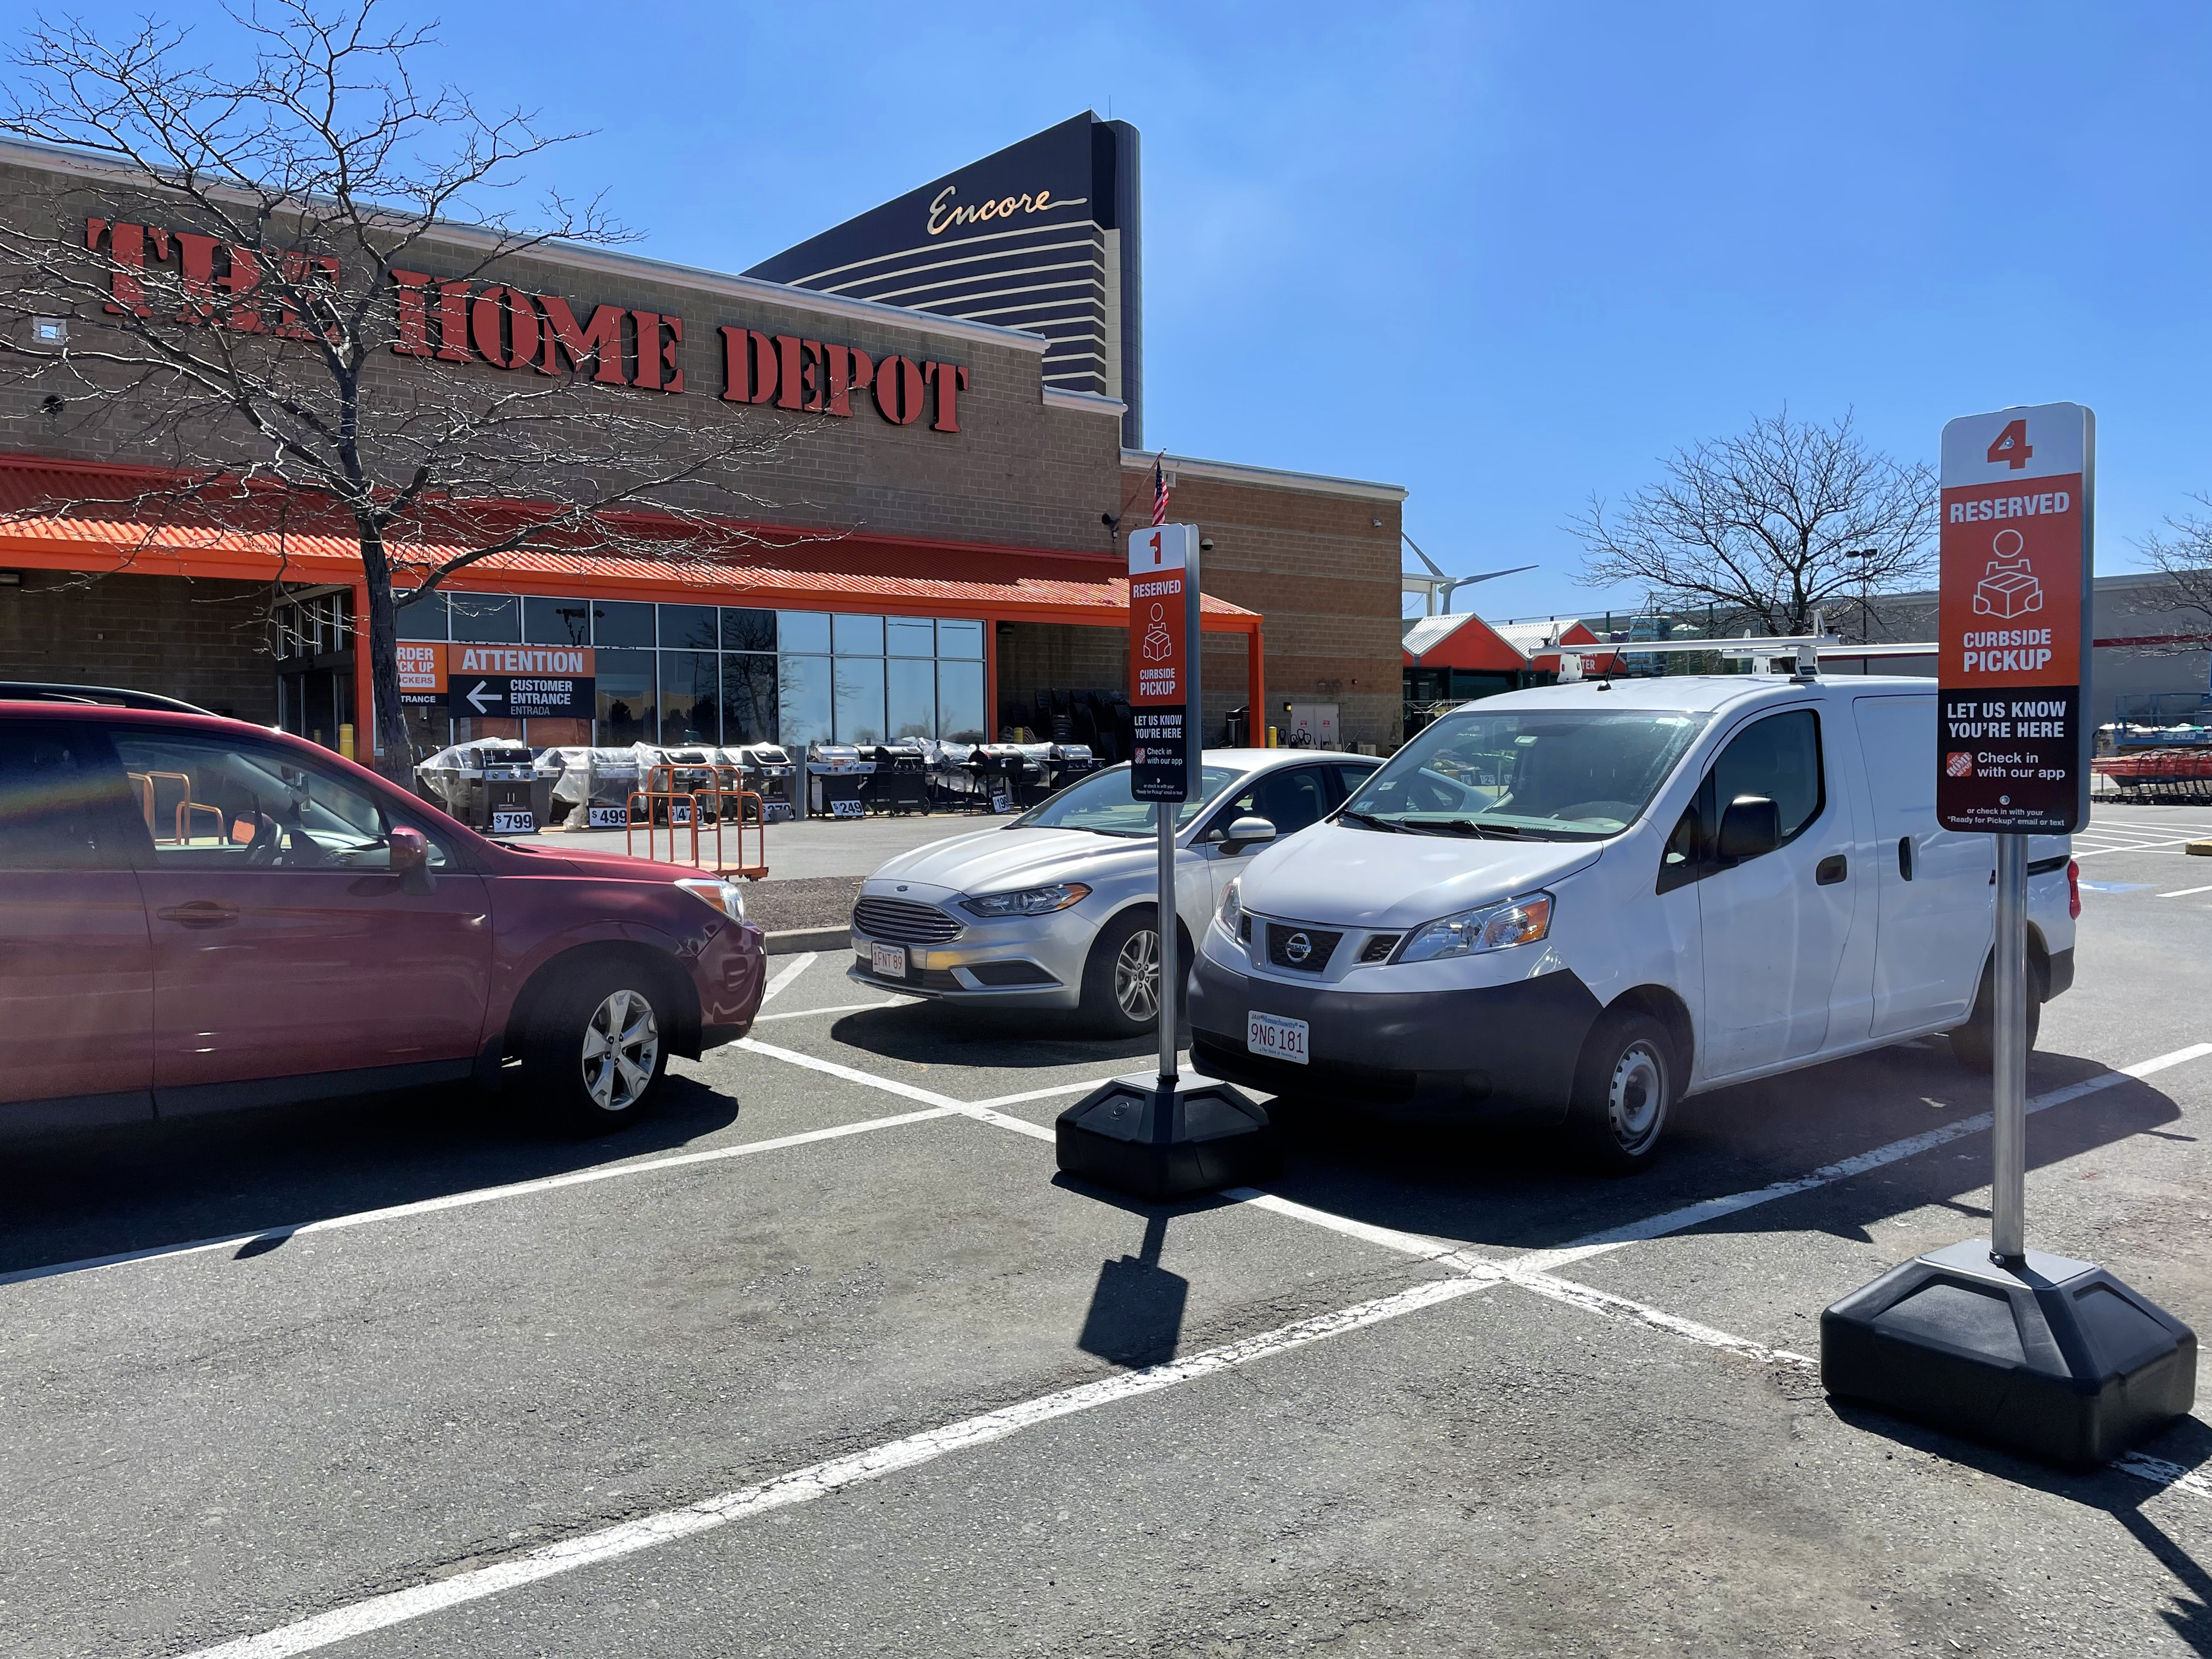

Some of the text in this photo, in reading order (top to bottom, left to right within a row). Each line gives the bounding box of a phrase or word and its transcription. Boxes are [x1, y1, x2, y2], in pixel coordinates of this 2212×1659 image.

[927, 185, 1087, 235] Encore
[87, 218, 969, 432] THE HOME DEPOT
[1987, 419, 2033, 470] 4
[1950, 492, 2069, 523] RESERVED
[1149, 532, 1162, 564] 1
[1133, 579, 1181, 598] RESERVED
[1963, 629, 2051, 648] CURBSIDE
[397, 647, 433, 661] RDER
[462, 649, 583, 673] ATTENTION
[1963, 648, 2052, 673] PICKUP
[397, 661, 435, 673] CK UP
[1581, 659, 1595, 670] TER
[1139, 668, 1175, 681] CURBSIDE
[510, 680, 572, 692] CUSTOMER
[1139, 681, 1176, 696] PICKUP
[510, 693, 571, 705] ENTRANCE
[510, 706, 550, 715] ENTRADA
[1948, 701, 2066, 719] LET US KNOW
[1135, 714, 1182, 726] LET US KNOW
[1135, 727, 1182, 738] YOU'RE HERE
[1949, 721, 2064, 738] YOU'RE HERE
[1977, 752, 2039, 763] Check in
[1977, 766, 2066, 780] with our app
[874, 951, 902, 969] 1FNT 89
[1262, 1015, 1295, 1029] Massachusetts
[1251, 1023, 1304, 1053] 9NG 181
